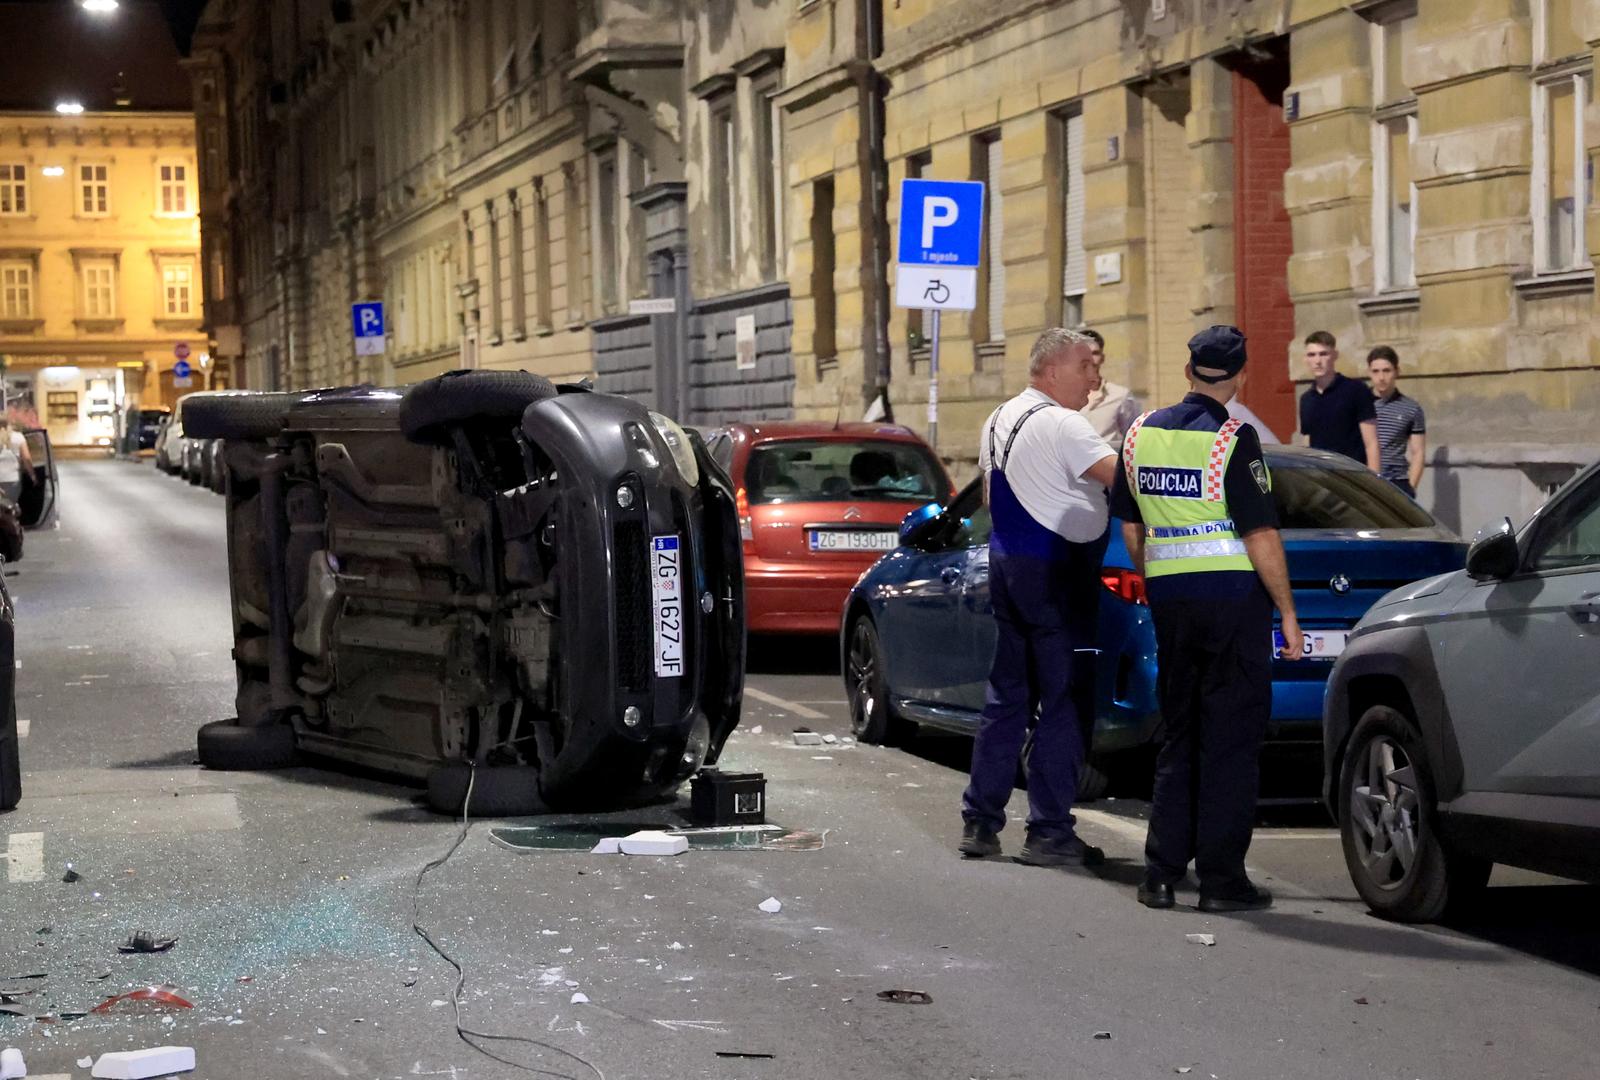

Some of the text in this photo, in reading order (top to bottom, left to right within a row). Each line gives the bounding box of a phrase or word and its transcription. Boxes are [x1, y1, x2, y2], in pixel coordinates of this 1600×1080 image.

[921, 195, 959, 249] P
[360, 308, 376, 332] P
[1139, 471, 1199, 493] POLICIJA
[820, 532, 836, 548] ZG
[658, 552, 677, 578] ZG
